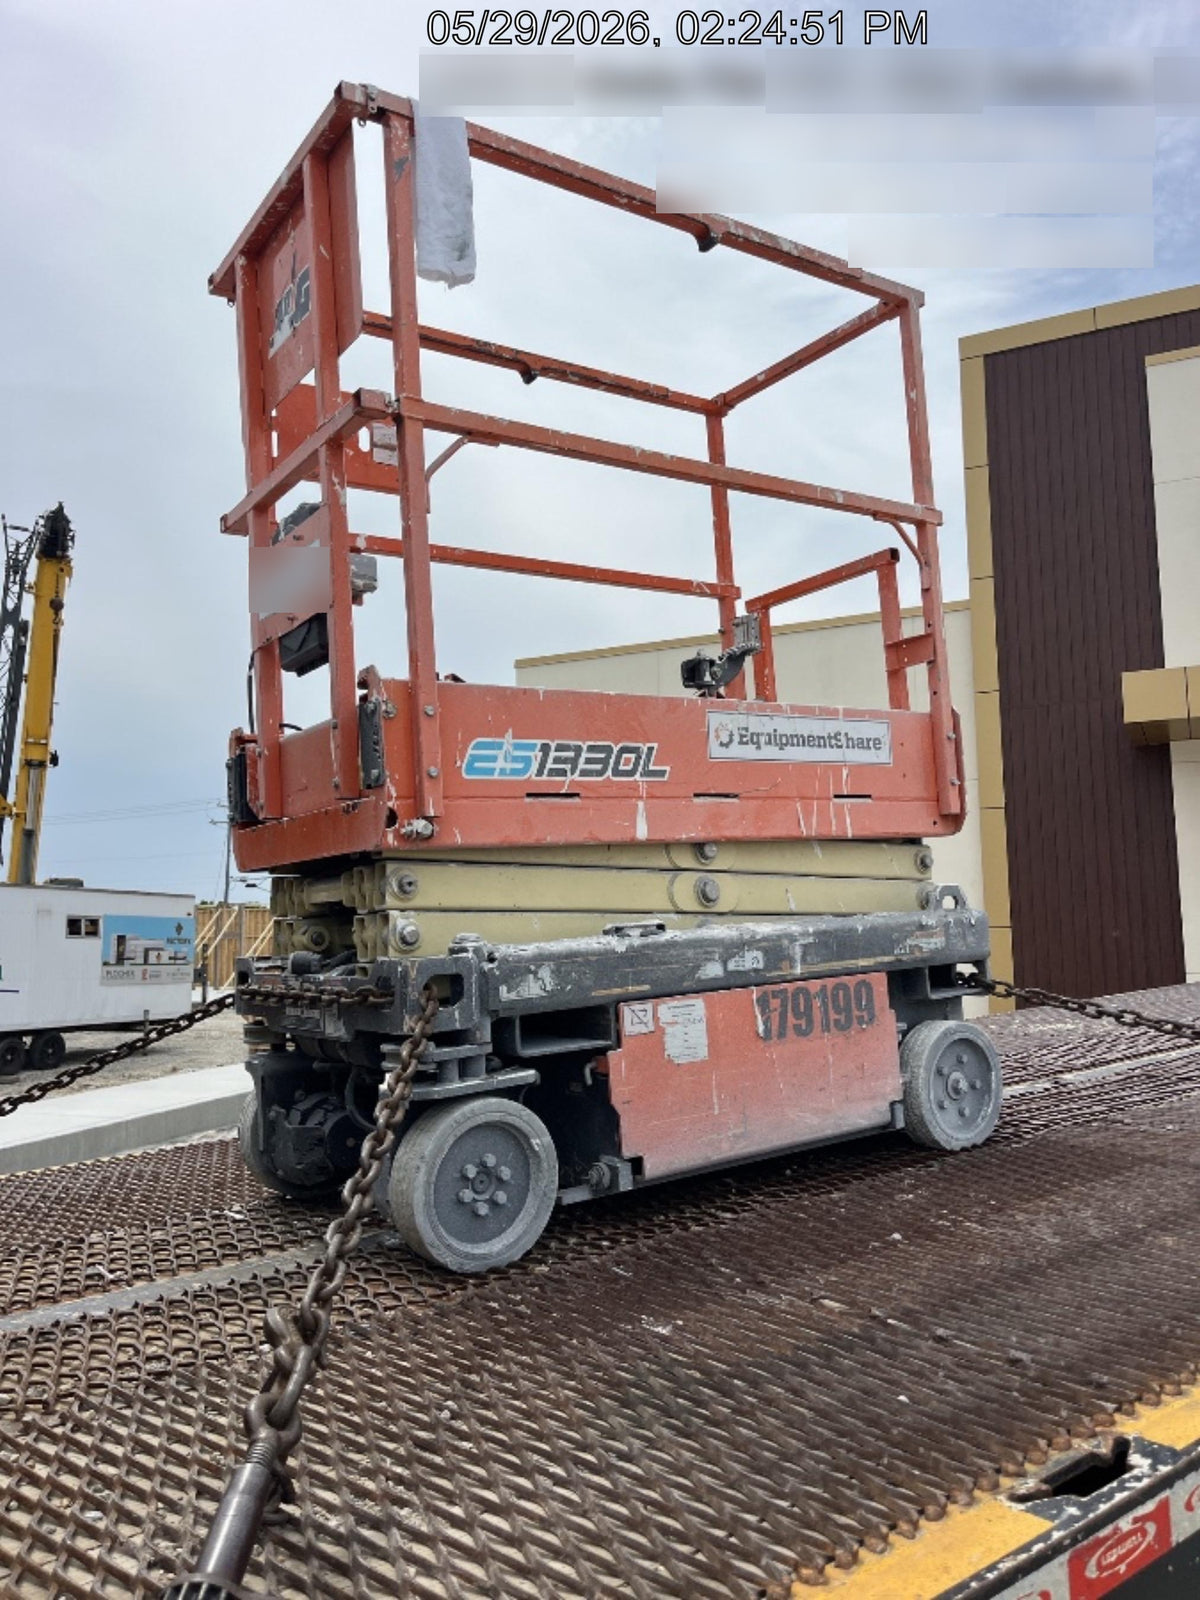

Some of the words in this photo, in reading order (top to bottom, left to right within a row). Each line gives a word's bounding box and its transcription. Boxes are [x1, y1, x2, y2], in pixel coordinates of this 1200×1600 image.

[462, 738, 671, 781] ES1330L
[737, 726, 882, 751] EquipmentShare
[755, 978, 876, 1042] 179199
